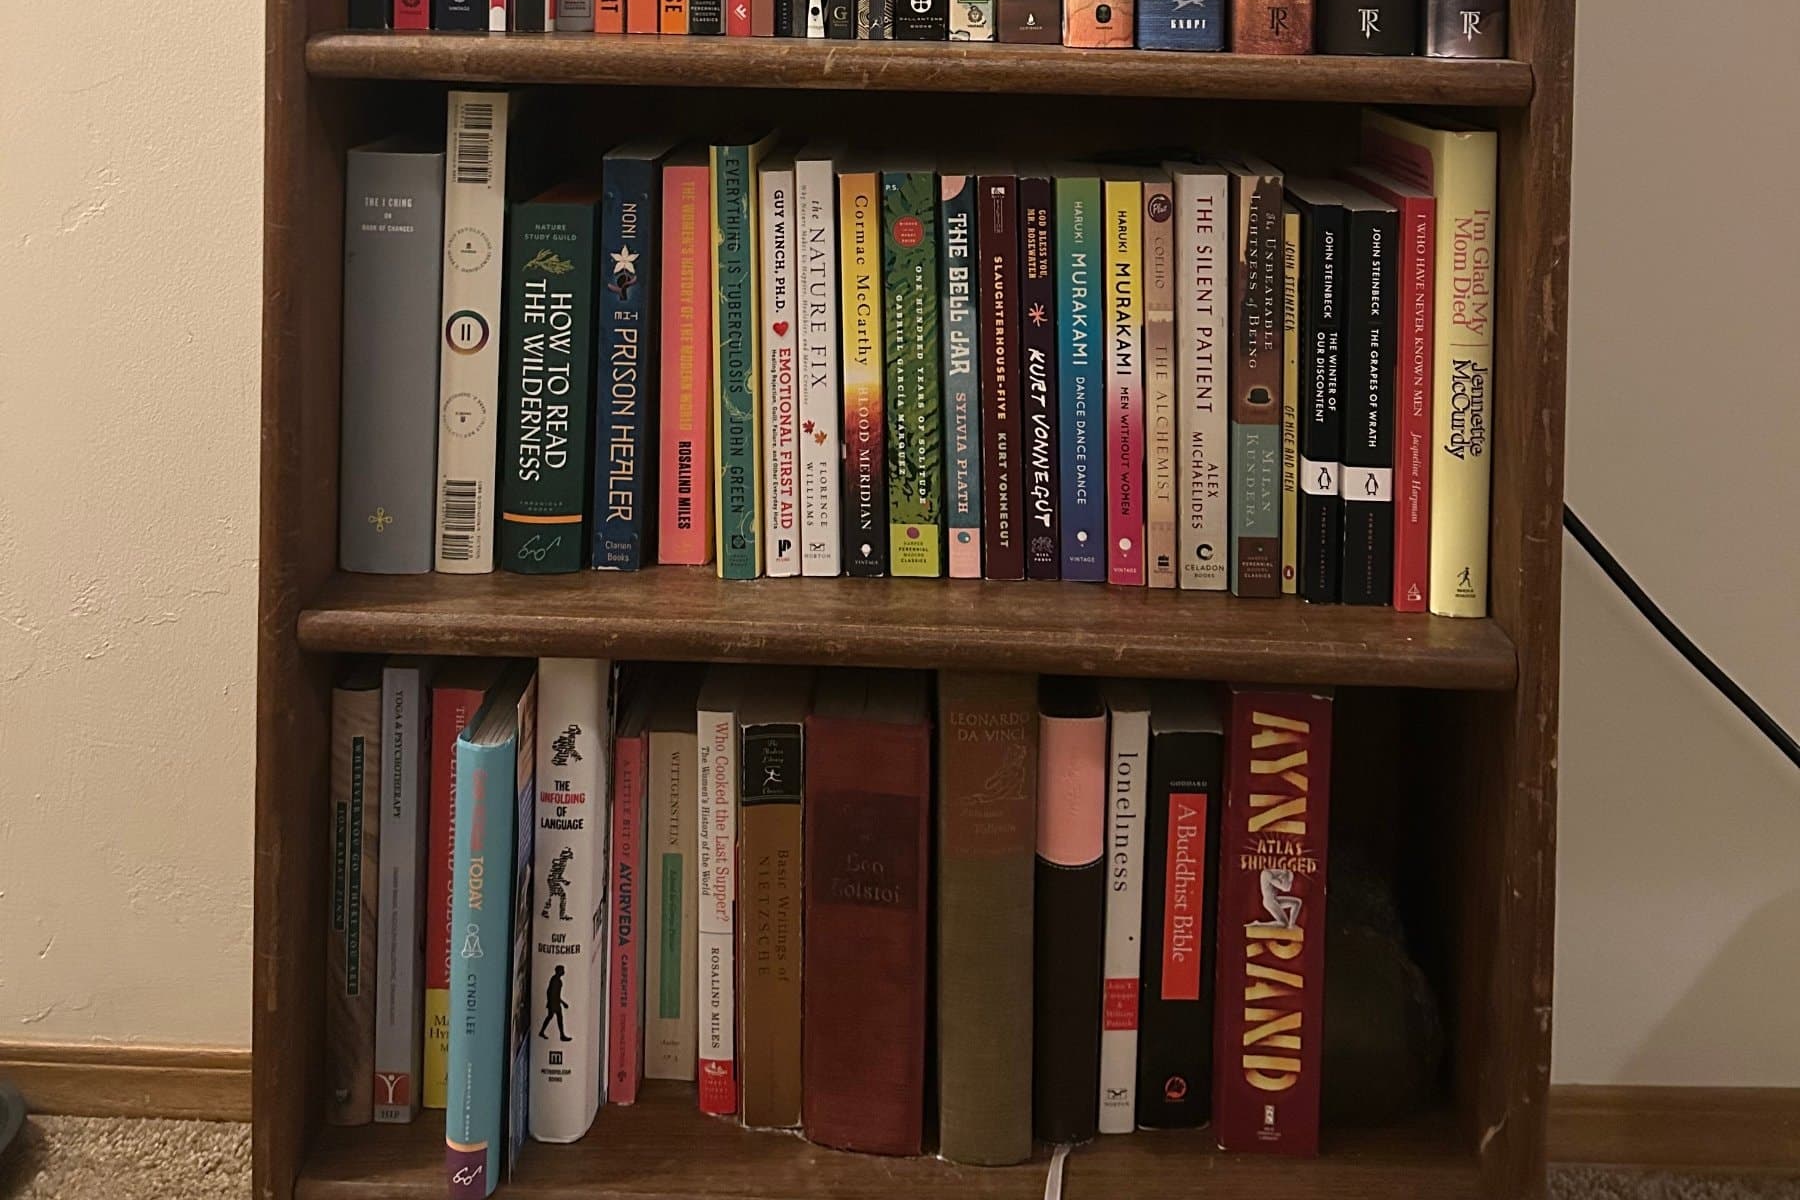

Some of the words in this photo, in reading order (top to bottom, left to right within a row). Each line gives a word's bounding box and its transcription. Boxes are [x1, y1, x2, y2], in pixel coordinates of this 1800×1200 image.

[622, 203, 637, 239] NONI
[948, 213, 968, 259] THE
[1117, 210, 1127, 253] HARUKI
[1196, 195, 1213, 234] THE
[1475, 208, 1491, 241] I'm
[1372, 227, 1381, 256] JOHN
[1415, 223, 1426, 254] WHO
[1453, 217, 1473, 272] Mom
[1196, 246, 1213, 316] SILENT
[1370, 260, 1381, 316] STEINBECK
[1414, 258, 1425, 290] HAVE
[1472, 246, 1490, 296] Glad
[524, 279, 547, 323] THE
[949, 266, 969, 322] BELL
[1414, 293, 1424, 333] NEVER
[1452, 276, 1472, 326] Died
[549, 294, 573, 354] HOW
[1115, 262, 1132, 375] MURAKAMI
[1370, 329, 1380, 348] THE
[1471, 302, 1489, 336] My
[610, 329, 639, 416] PRISON
[949, 332, 971, 376] JAR
[1196, 327, 1213, 413] PATIENT
[1369, 351, 1379, 391] GRAPES
[1413, 337, 1424, 386] KNOWN
[547, 363, 570, 395] TO
[779, 348, 792, 447] EMOTIONAL
[1120, 387, 1129, 410] MEN
[1368, 394, 1378, 407] OF
[518, 334, 545, 481] WILDERNESS
[956, 392, 967, 452] SYLVIA
[1413, 389, 1423, 417] MEN
[1444, 358, 1473, 461] McCurdy
[1469, 362, 1489, 457] Jennette
[545, 405, 568, 469] READ
[1120, 413, 1130, 464] WITHOUT
[1367, 411, 1378, 448] WRATH
[606, 425, 635, 521] HEALER
[678, 441, 692, 497] ROSALIND
[780, 450, 792, 497] FIRST
[957, 459, 969, 513] PLATH
[1191, 431, 1204, 530] MICHAELIDES
[1207, 463, 1219, 497] ALEX
[1120, 468, 1131, 516] WOMEN
[677, 500, 691, 530] MILES
[781, 502, 793, 529] AID
[715, 722, 729, 751] Who
[555, 780, 571, 791] THE
[714, 756, 729, 804] Cooked
[1247, 711, 1310, 835] AYN
[540, 791, 586, 804] UNFOLDING
[557, 807, 568, 817] OF
[715, 809, 729, 830] the
[1178, 804, 1195, 820] A
[540, 817, 585, 830] LANGUAGE
[1113, 753, 1139, 893] loneliness
[715, 835, 730, 862] Last
[1172, 825, 1197, 911] Buddhist
[1240, 855, 1317, 873] SHRUGGED
[1257, 840, 1302, 855] ATLAS
[712, 866, 731, 922] Supper?
[538, 942, 581, 954] DEUTSCHER
[552, 932, 566, 942] GUY
[1172, 915, 1194, 962] Bible
[468, 974, 477, 1010] CYNDI
[711, 947, 720, 1007] ROSALIND
[466, 1013, 476, 1035] LEE
[1243, 925, 1304, 1091] RAND
[711, 1012, 720, 1049] MILES
